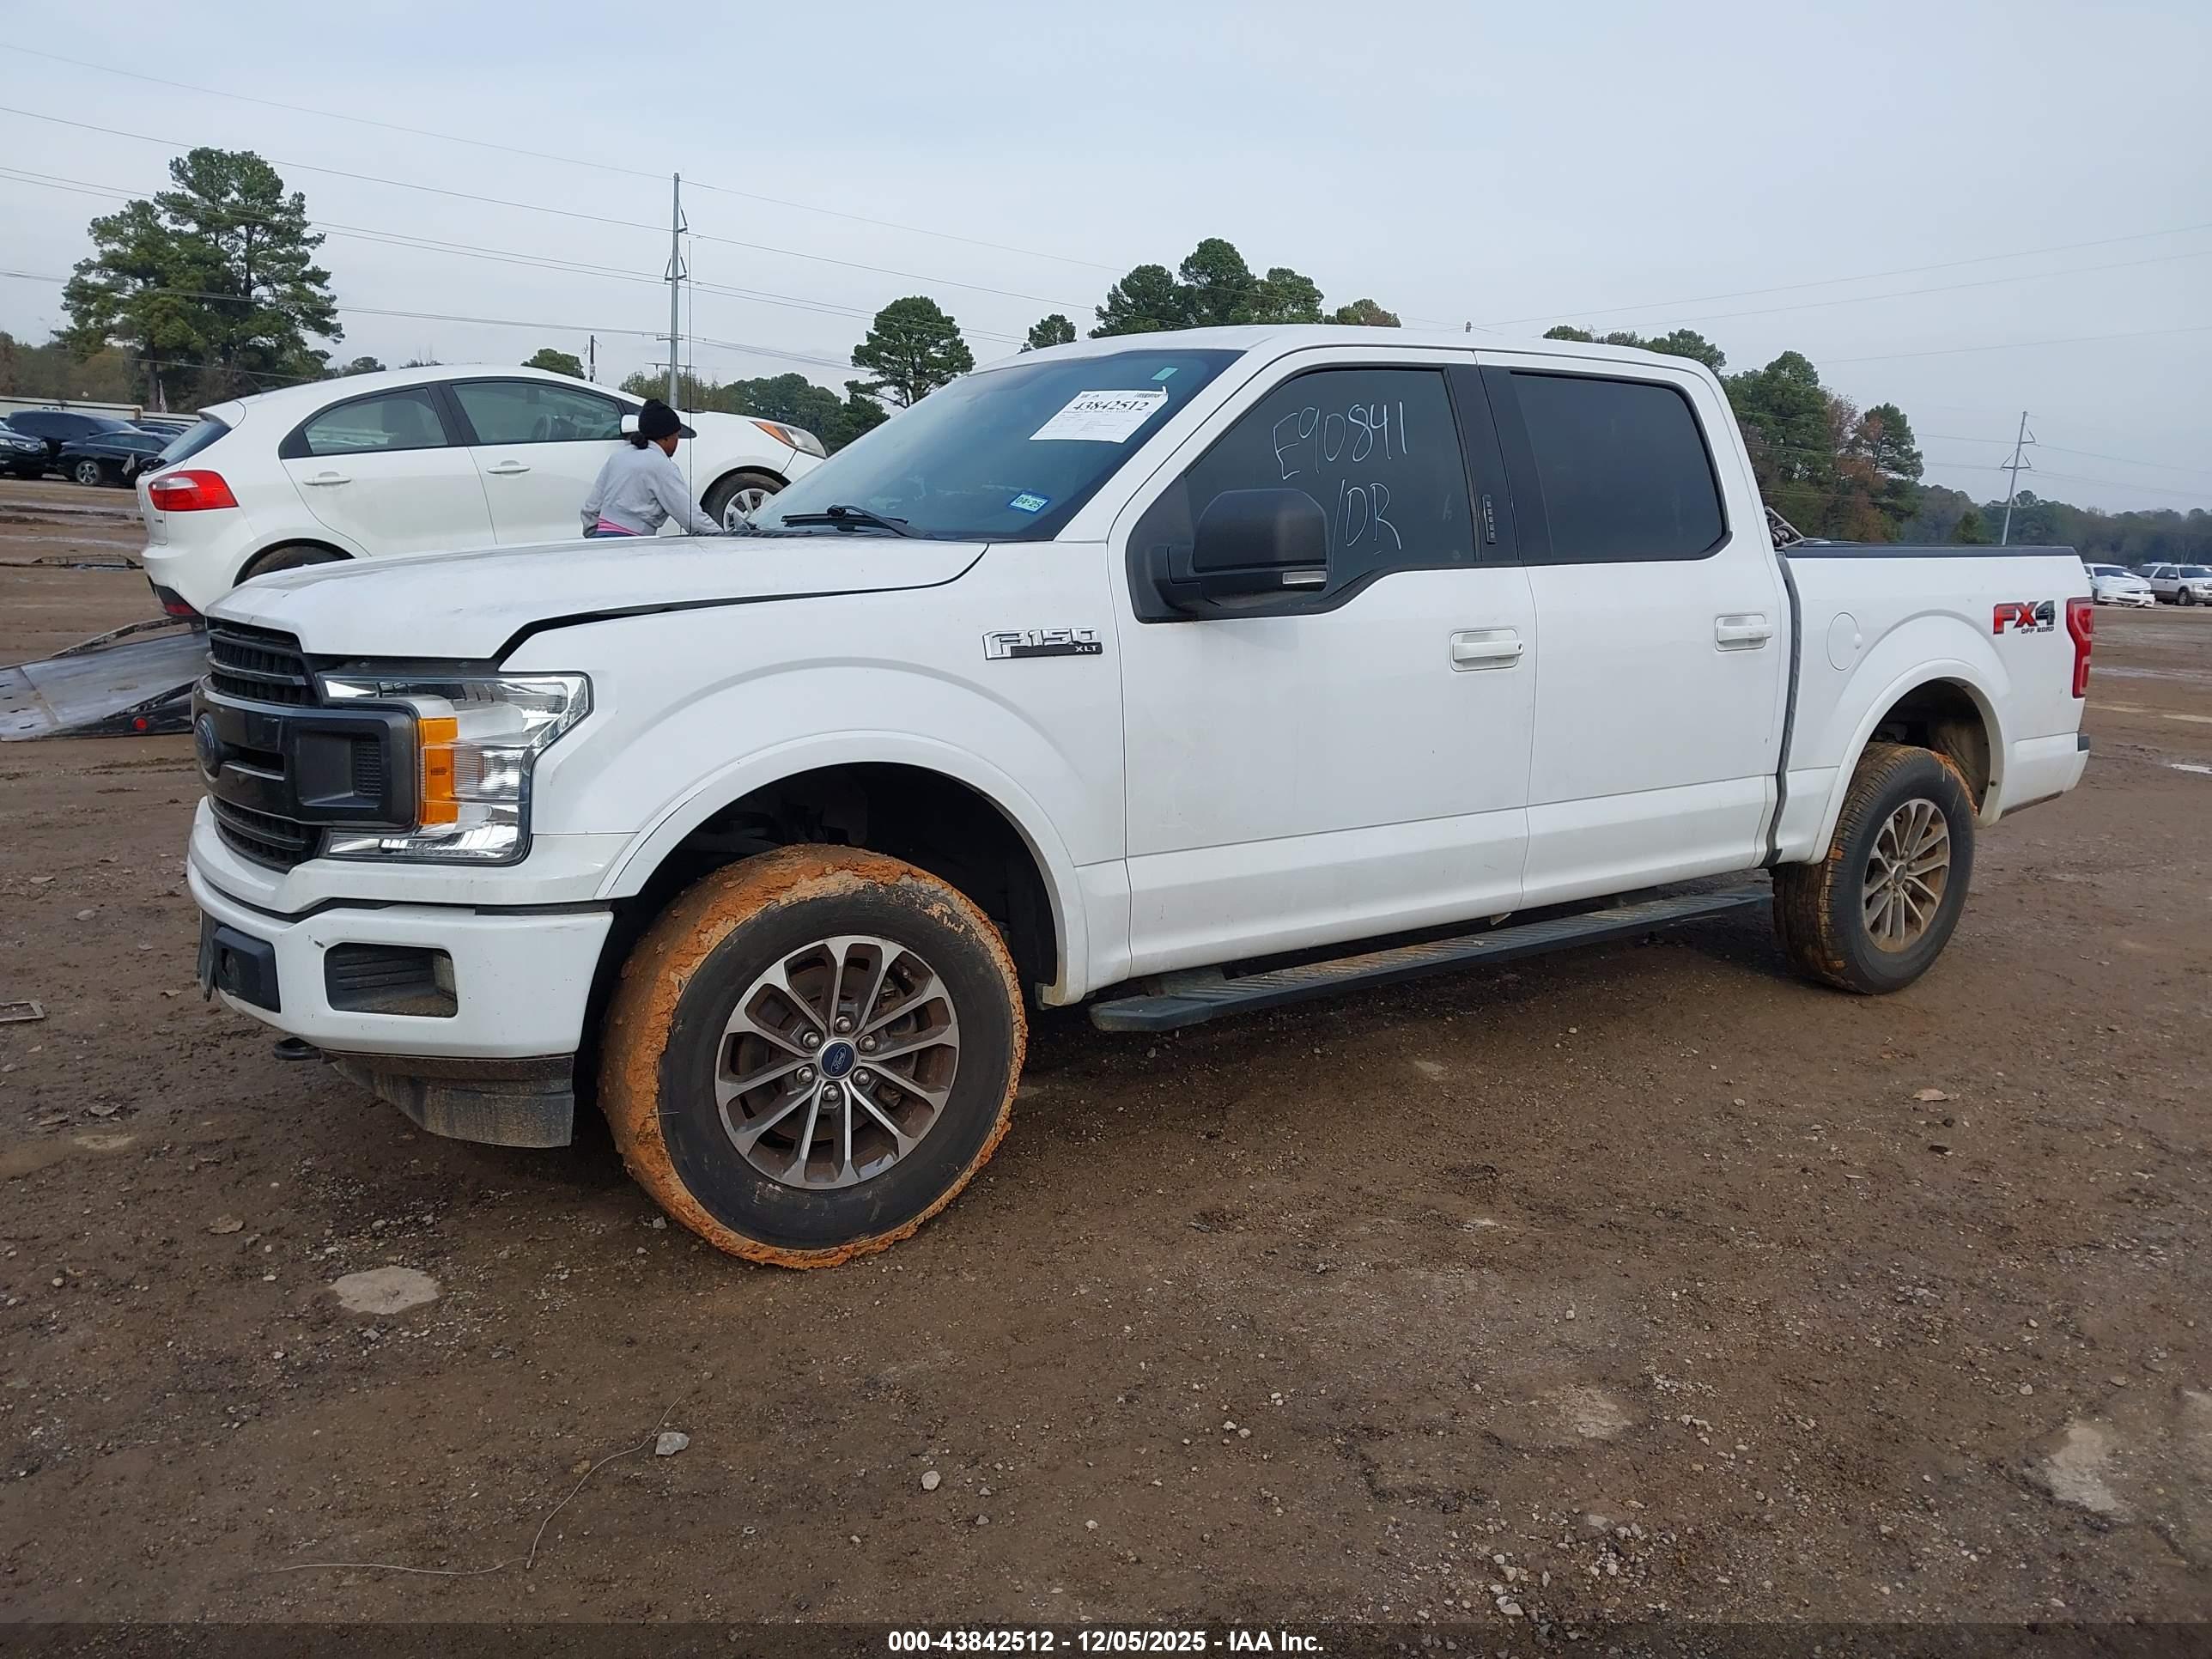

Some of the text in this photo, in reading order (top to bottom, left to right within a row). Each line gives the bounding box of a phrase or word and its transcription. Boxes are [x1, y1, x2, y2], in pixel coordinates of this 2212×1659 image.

[1073, 400, 1150, 411] 43842512
[1273, 400, 1407, 480] E90841
[1992, 599, 2056, 635] FX4
